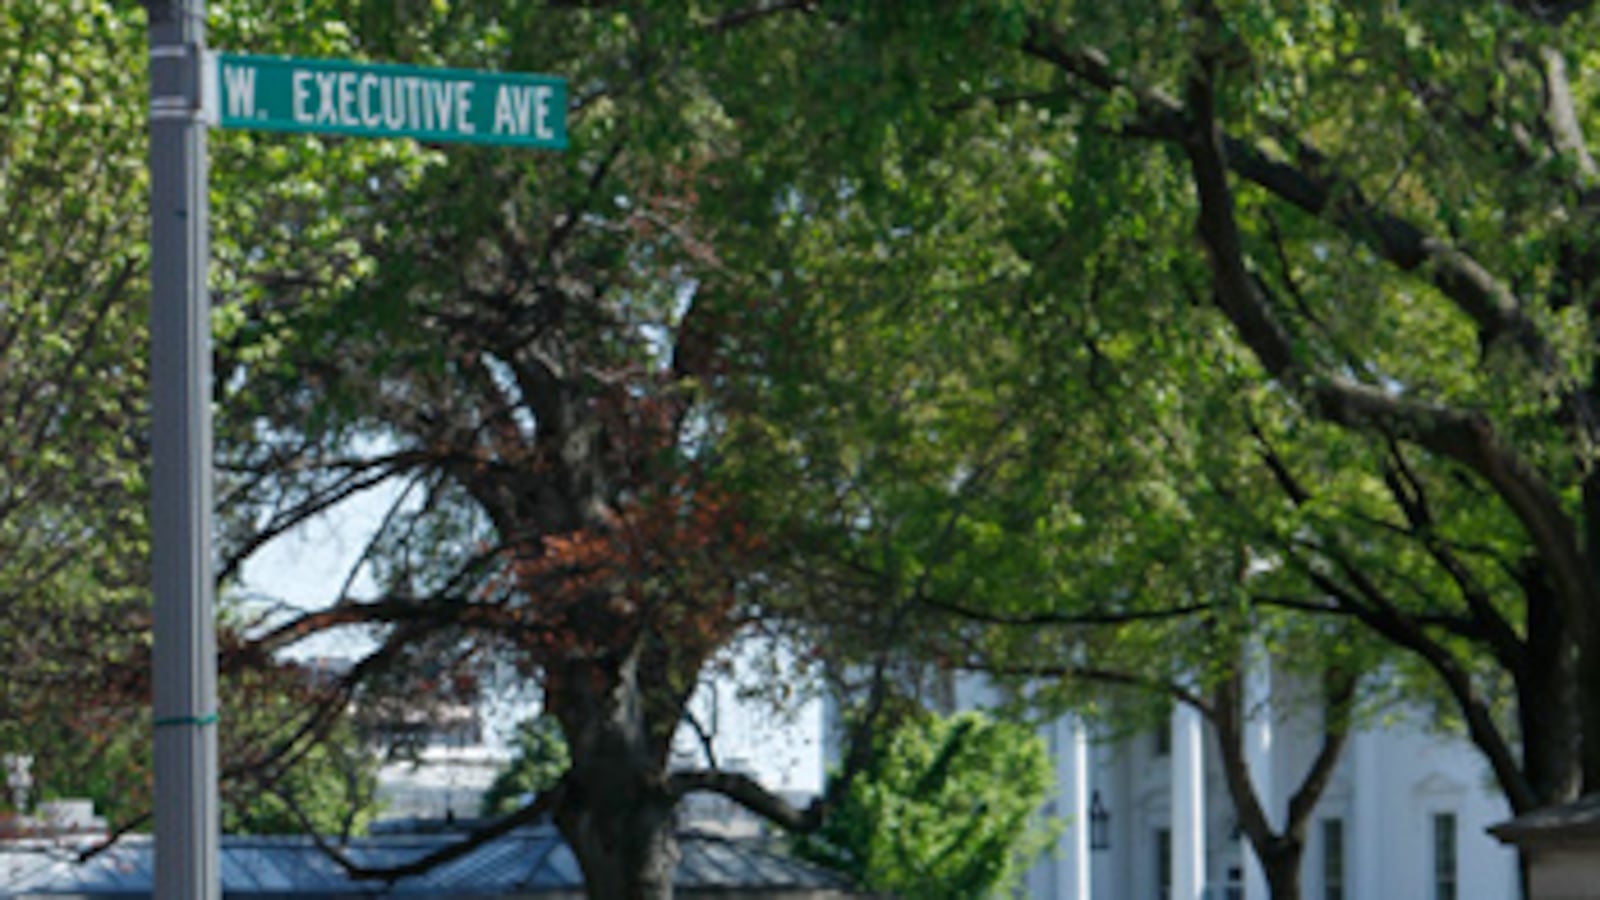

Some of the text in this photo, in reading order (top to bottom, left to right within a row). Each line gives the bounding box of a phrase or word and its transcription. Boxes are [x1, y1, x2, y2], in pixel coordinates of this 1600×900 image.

[223, 66, 555, 139] W. EXECUTIVE AVE
